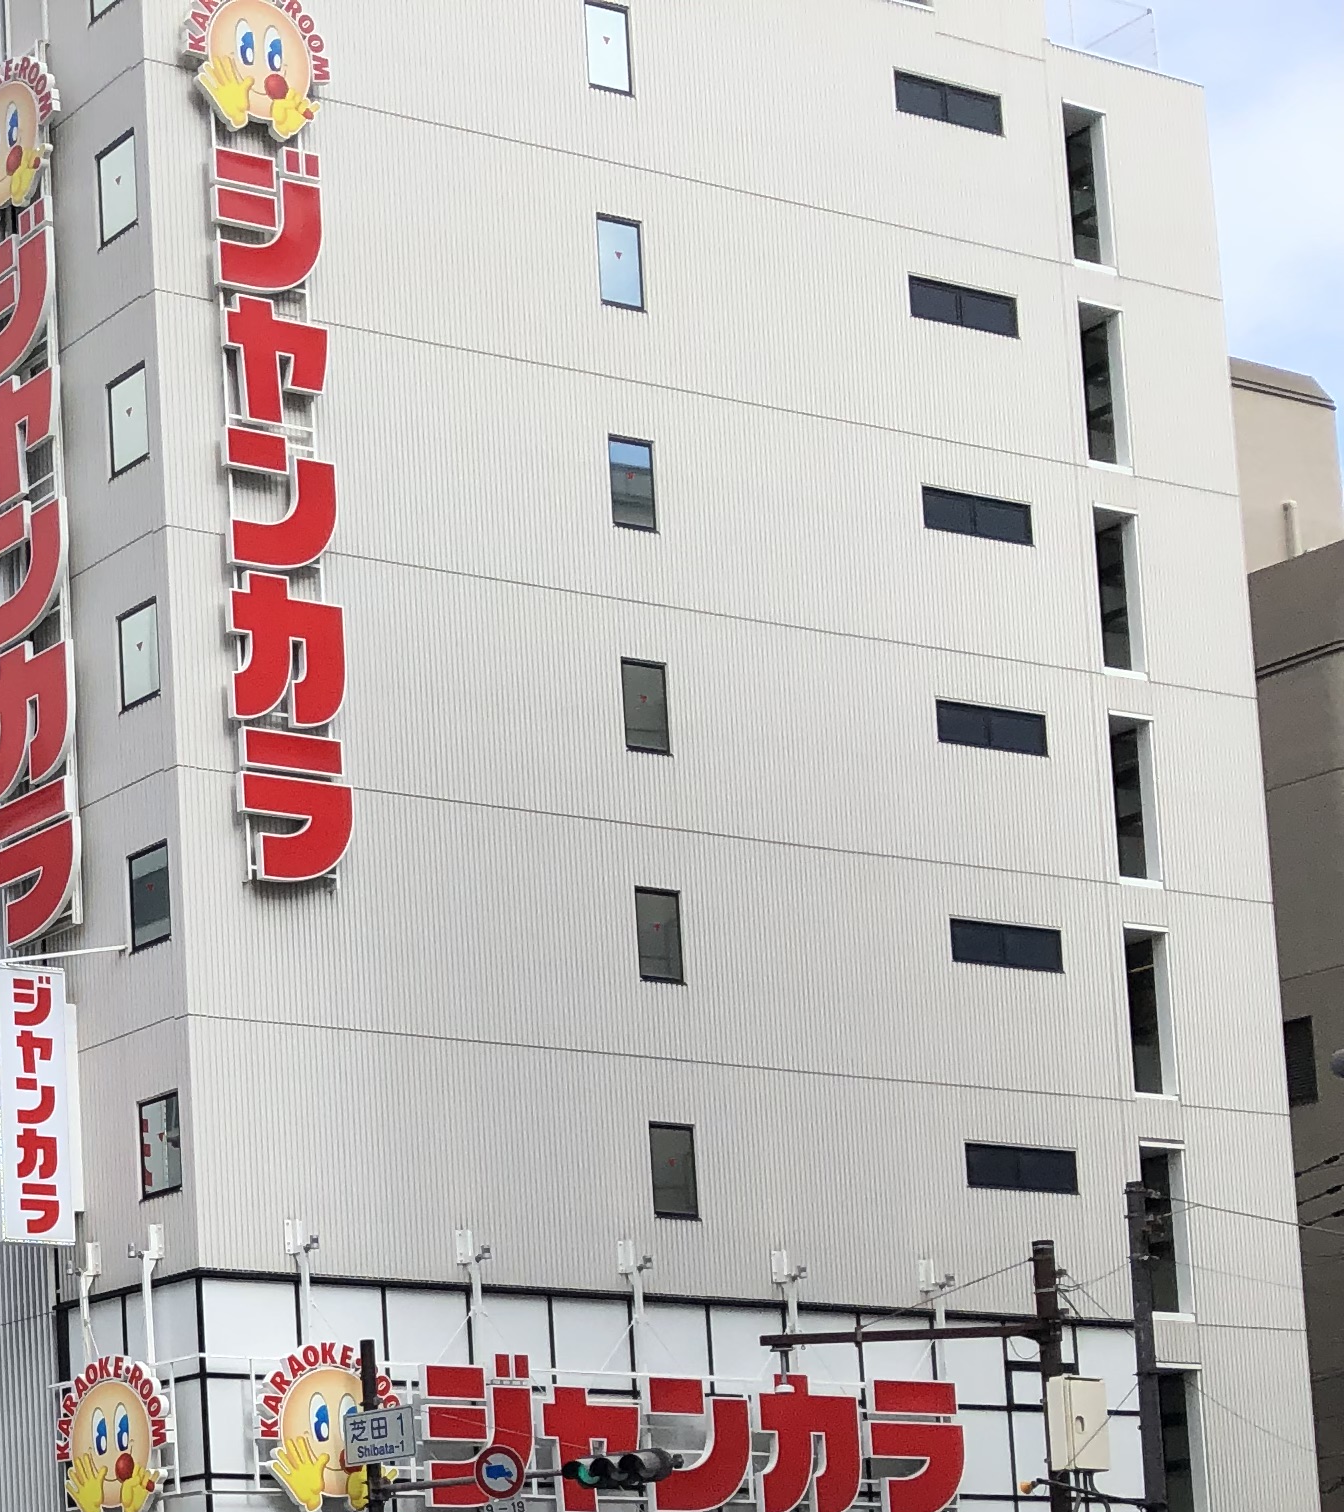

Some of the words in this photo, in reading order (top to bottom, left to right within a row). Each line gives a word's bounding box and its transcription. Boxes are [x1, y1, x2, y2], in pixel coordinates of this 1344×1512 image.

[214, 147, 354, 881] ジャンカラ
[12, 976, 60, 1235] ジャンカラ
[349, 1416, 388, 1444] 芝田
[396, 1413, 405, 1437] 1
[356, 1440, 405, 1459] Shibata-1
